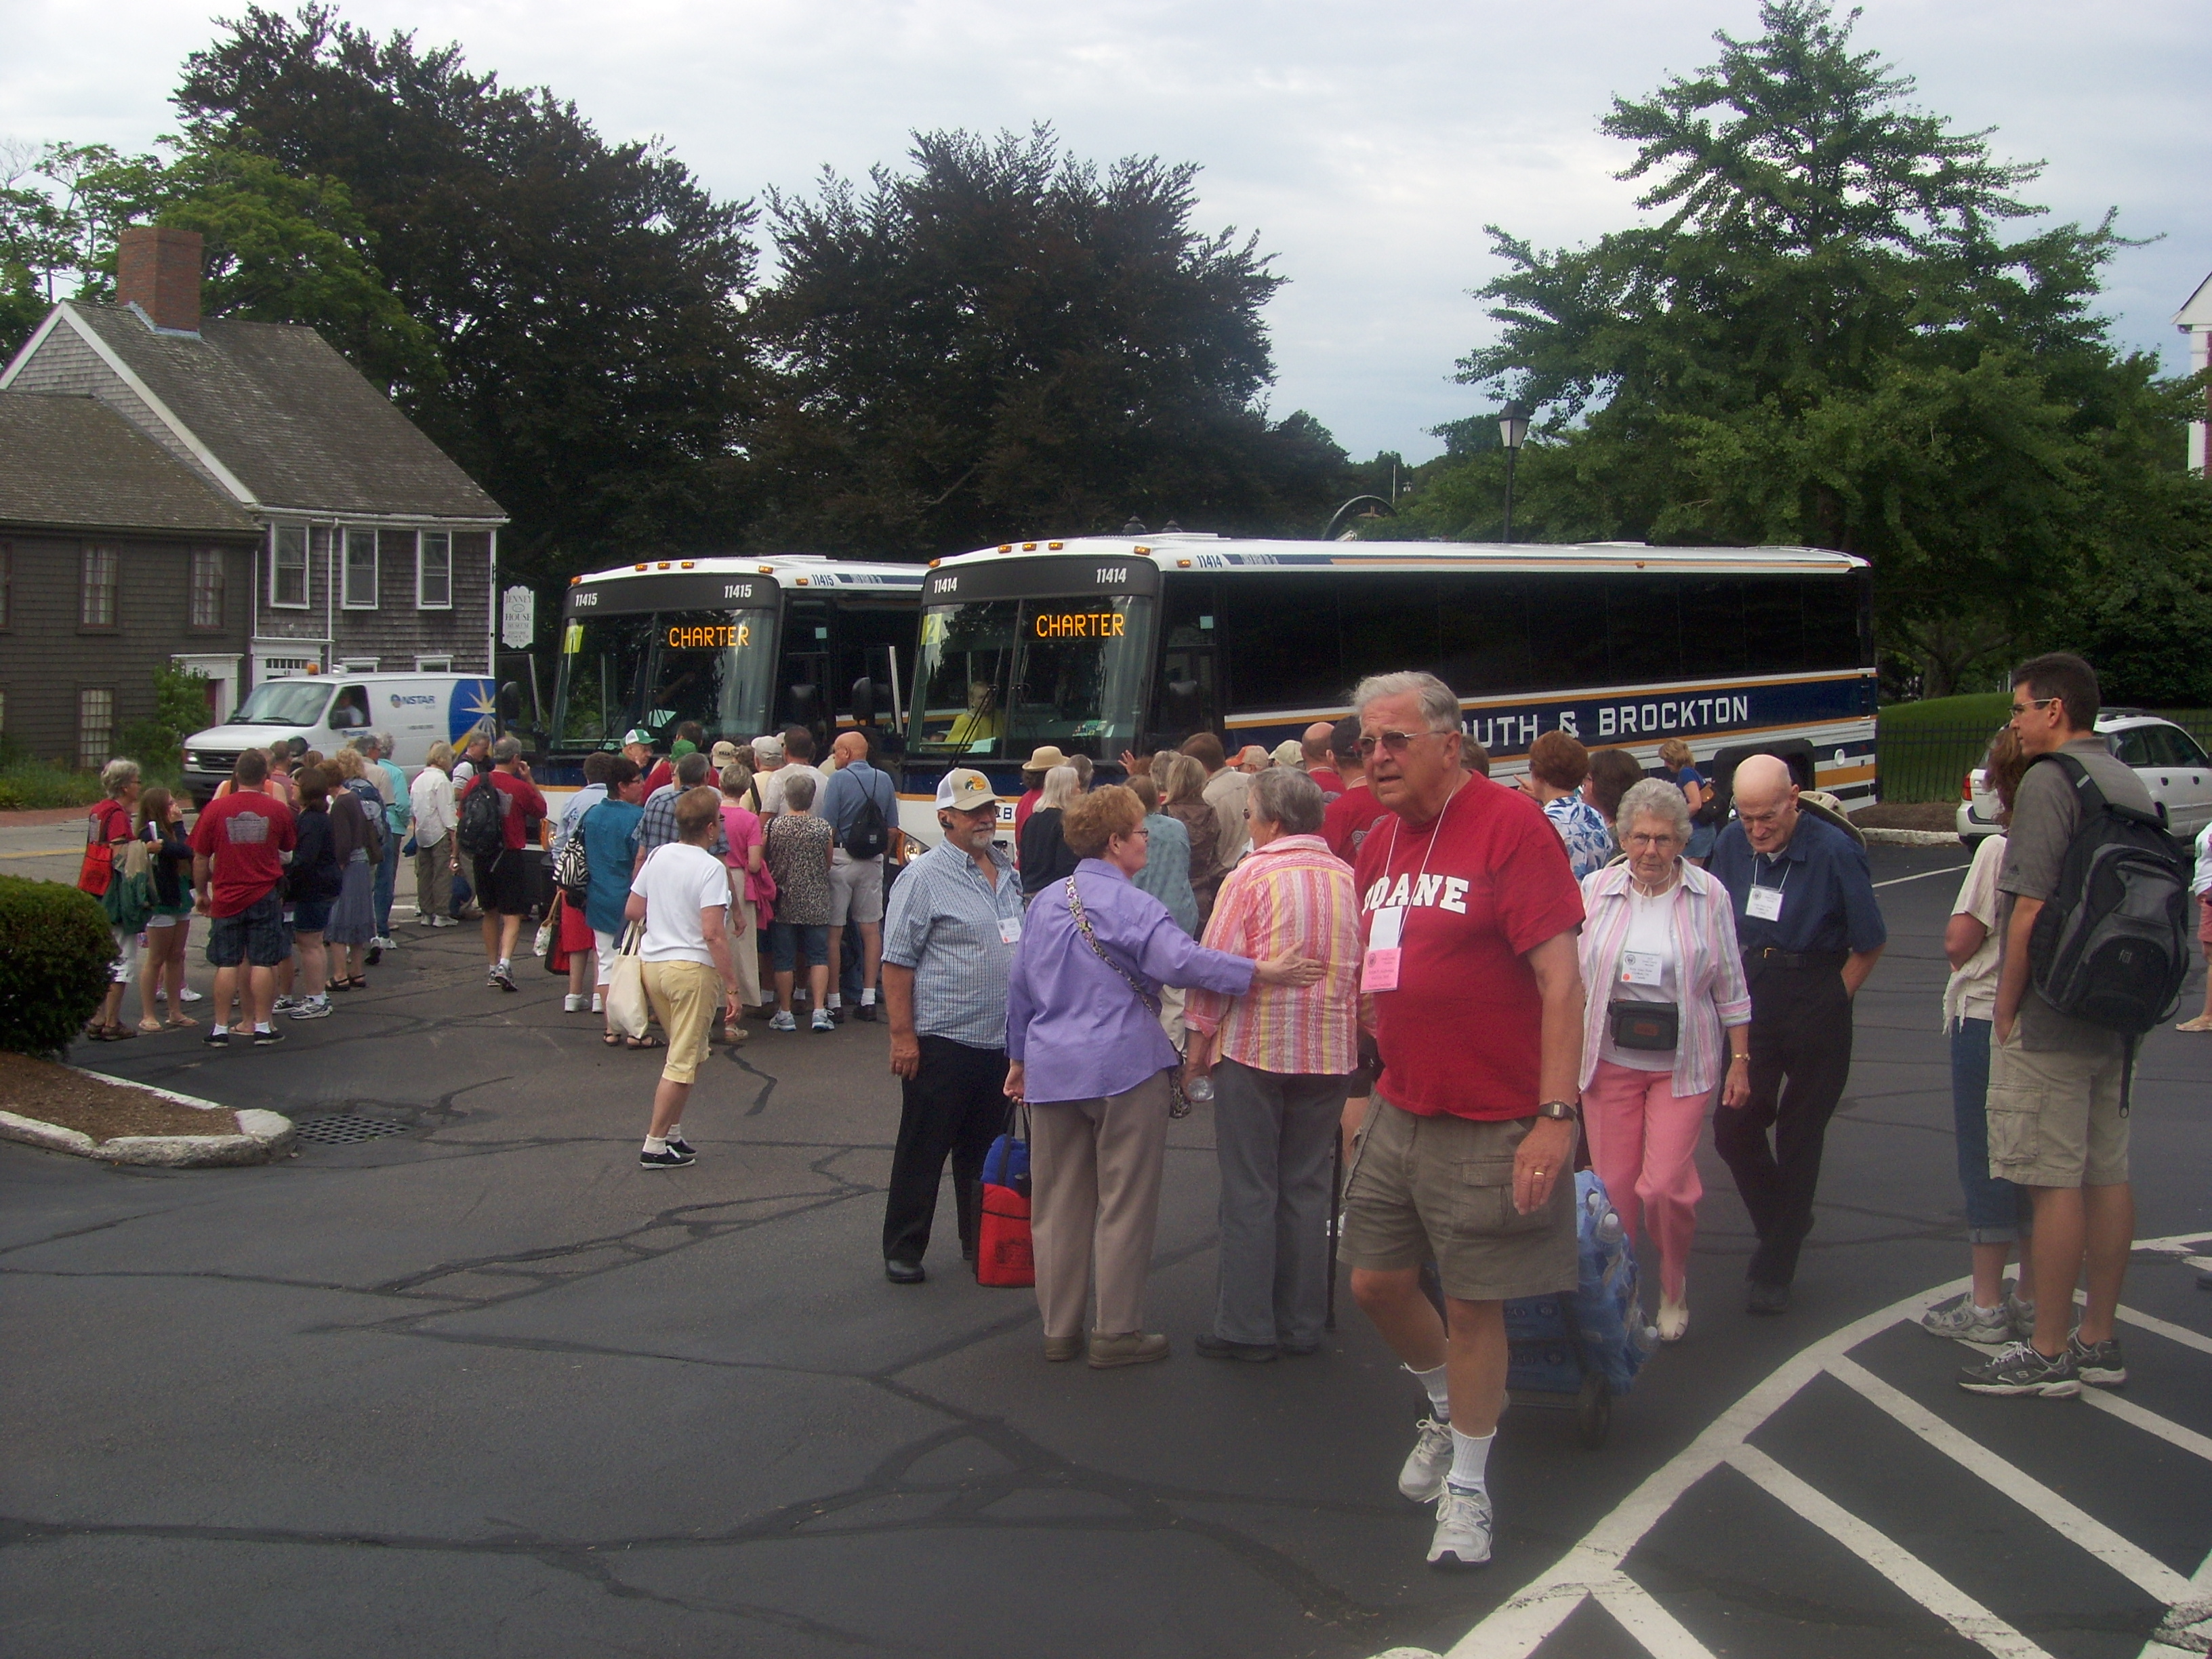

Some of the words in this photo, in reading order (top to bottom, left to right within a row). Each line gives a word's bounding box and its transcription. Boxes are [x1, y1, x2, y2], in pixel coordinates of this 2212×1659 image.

[1197, 555, 1223, 568] 11414
[812, 574, 835, 586] 11415
[1097, 568, 1127, 583] 11414
[724, 584, 752, 598] 11415
[934, 577, 958, 594] 11414
[575, 593, 598, 607] 11415
[1036, 614, 1124, 637] CHARTER
[670, 626, 750, 647] CHARTER
[402, 695, 435, 704] NSTAR
[1559, 712, 1580, 739] &
[1599, 696, 1748, 736] BROCKTON
